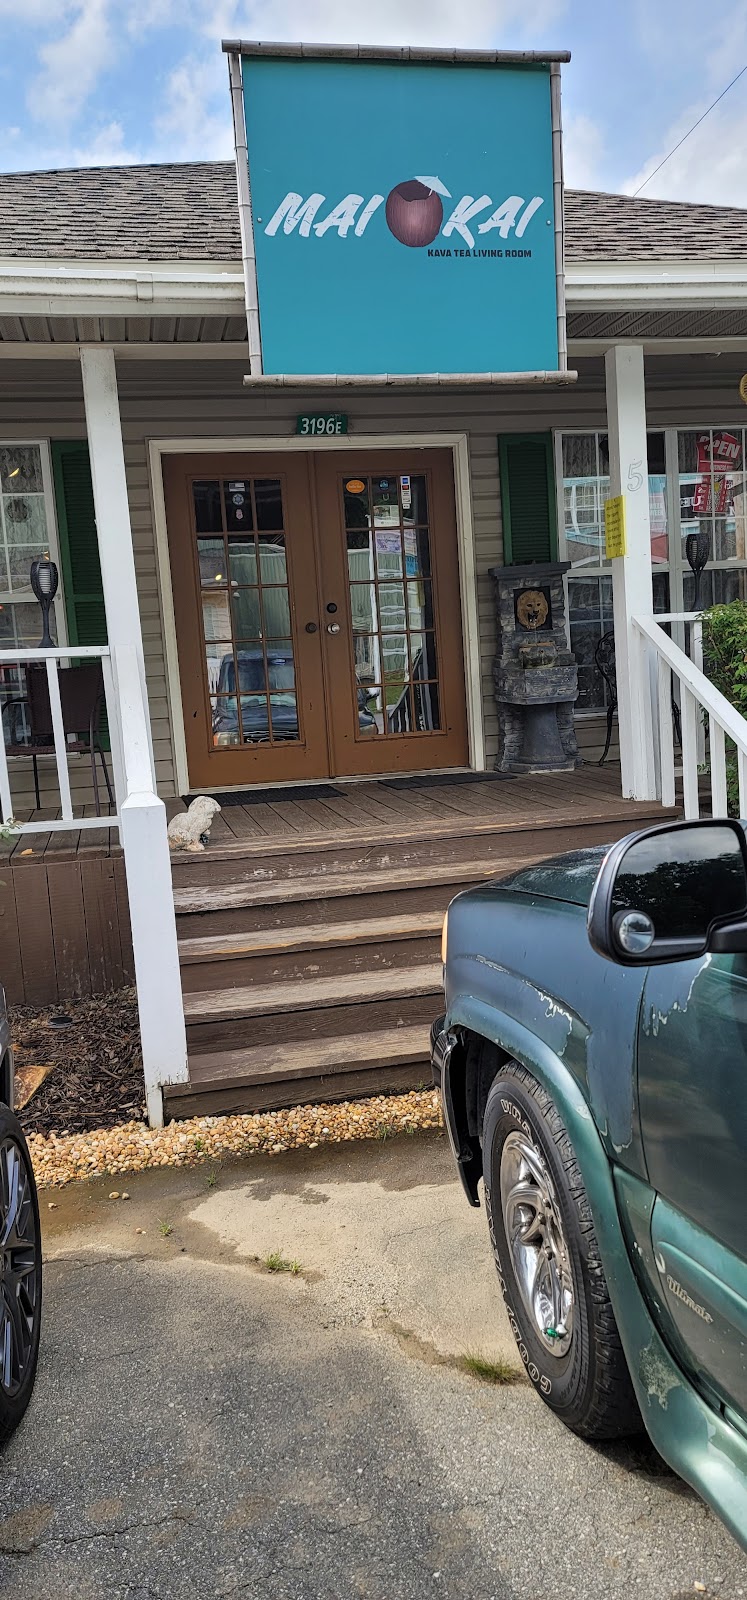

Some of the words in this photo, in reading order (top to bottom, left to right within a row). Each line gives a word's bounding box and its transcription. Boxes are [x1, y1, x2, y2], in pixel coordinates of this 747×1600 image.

[264, 191, 385, 238] MAI
[441, 194, 545, 250] KAI
[427, 249, 452, 257] KAVA
[453, 249, 471, 258] TEA
[473, 249, 503, 258] LIVING
[505, 249, 532, 258] ROOM
[627, 459, 644, 491] 5
[666, 1274, 714, 1325] Ultimate
